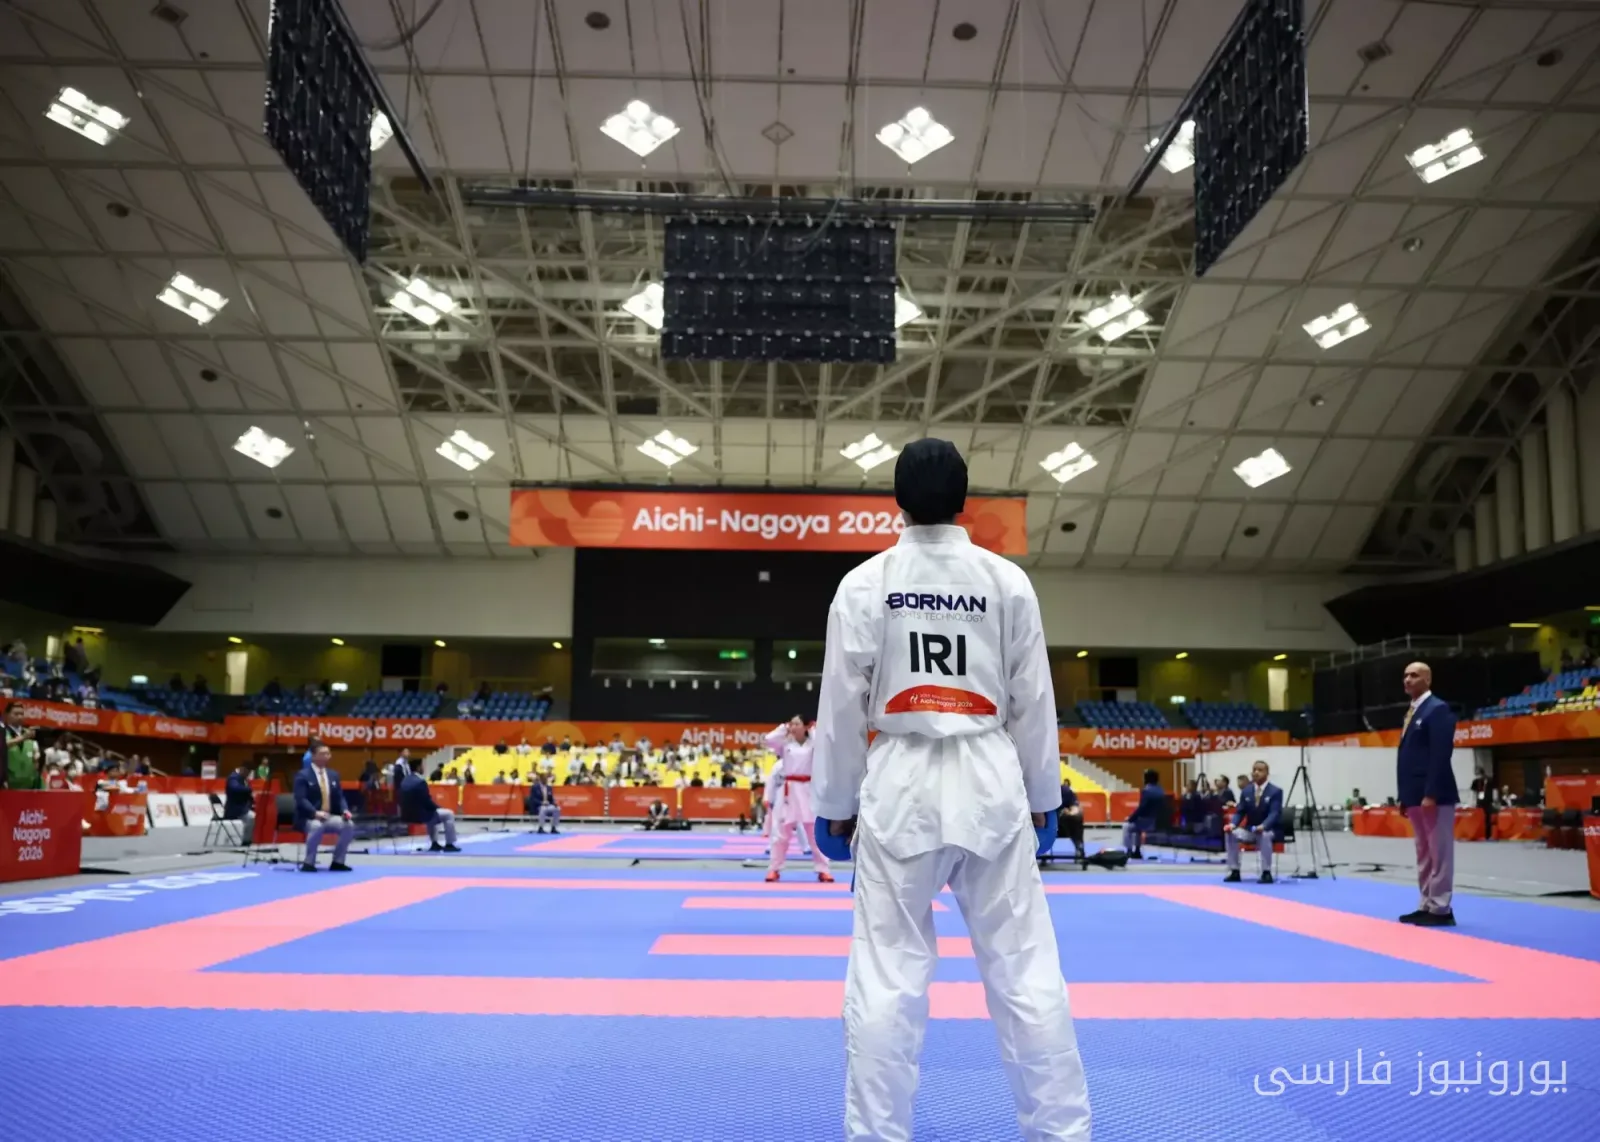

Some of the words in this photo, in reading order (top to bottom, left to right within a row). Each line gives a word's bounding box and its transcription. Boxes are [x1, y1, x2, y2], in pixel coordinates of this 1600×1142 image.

[633, 506, 829, 540] Aichi-Nagoya
[838, 511, 906, 534] 2026
[885, 592, 986, 613] BORNAN
[924, 612, 986, 622] TECHNOLOGY
[909, 631, 967, 676] IRI
[265, 720, 387, 743] Aichi-Nagoya
[391, 723, 437, 740] 2026
[1215, 735, 1258, 750] 2026
[18, 809, 48, 825] Aichi-
[12, 826, 51, 846] Nagoya
[18, 846, 44, 861] 2026
